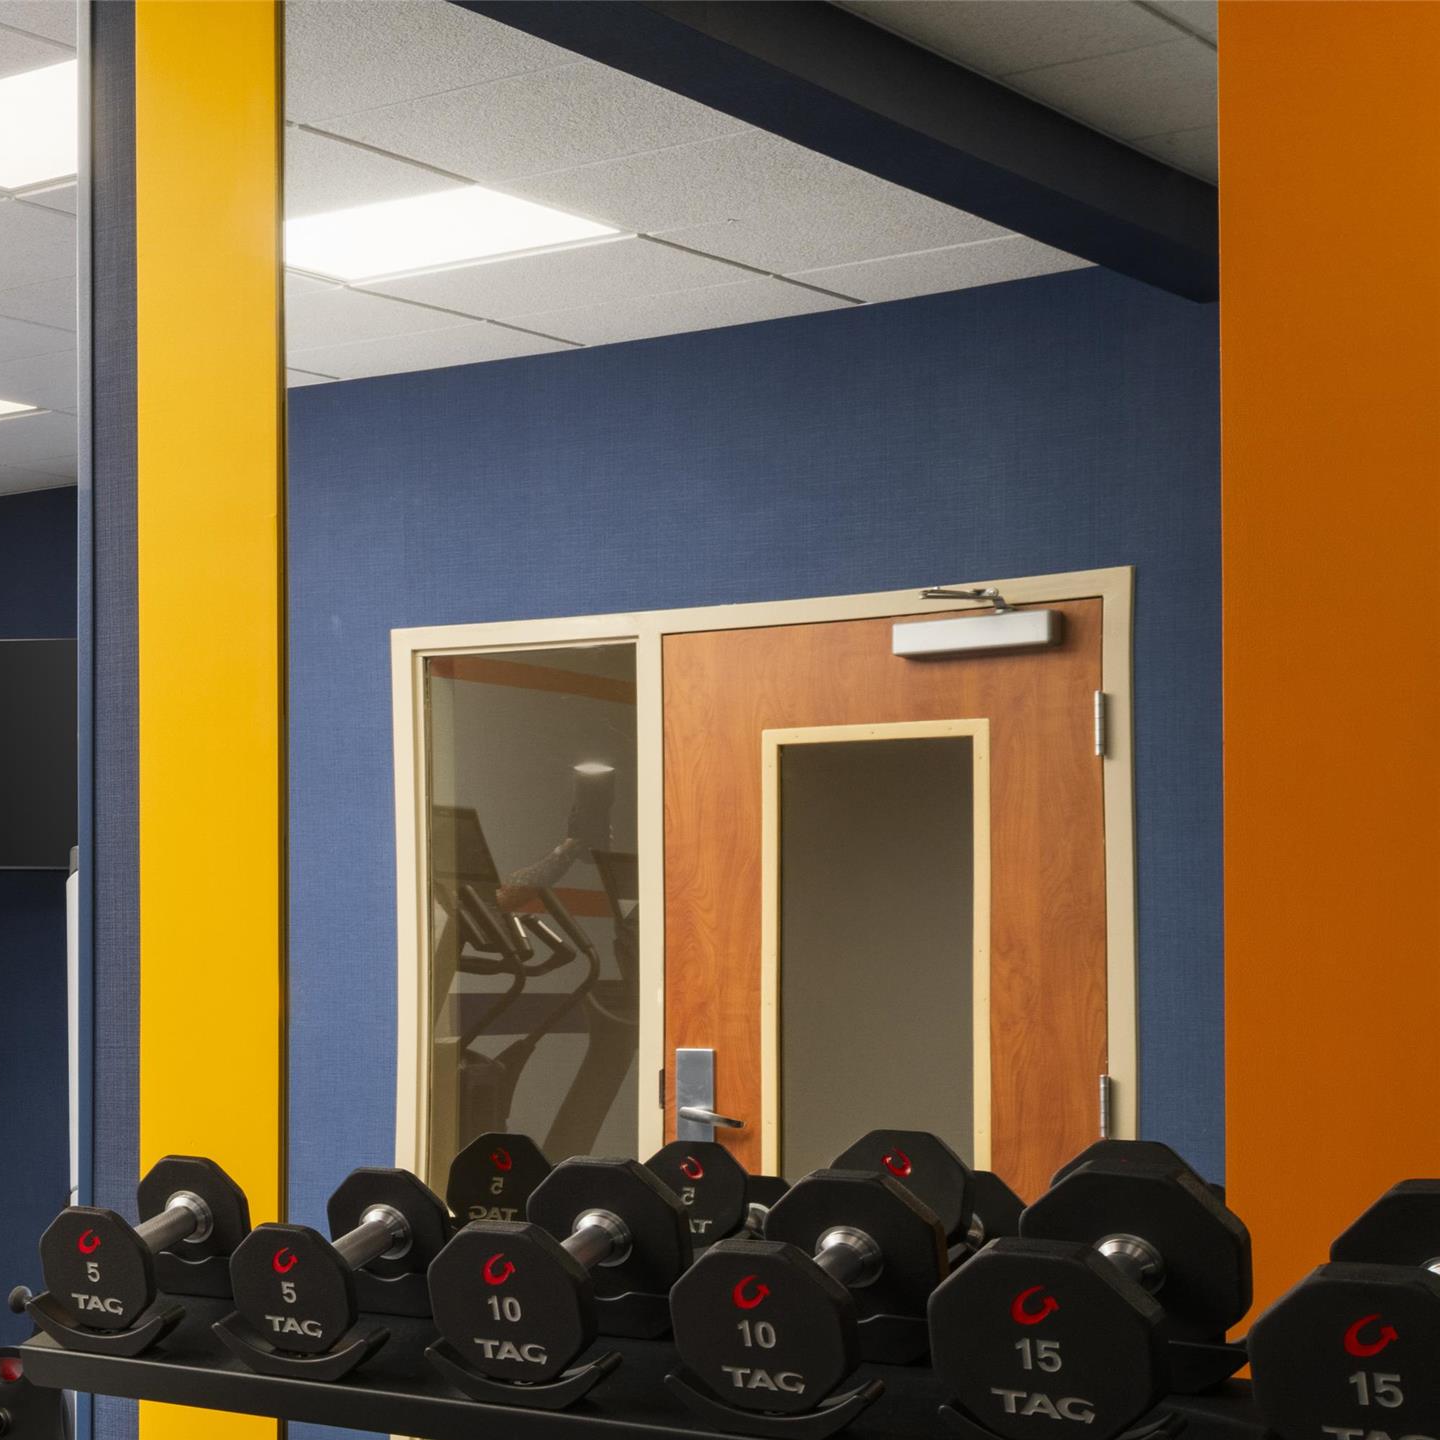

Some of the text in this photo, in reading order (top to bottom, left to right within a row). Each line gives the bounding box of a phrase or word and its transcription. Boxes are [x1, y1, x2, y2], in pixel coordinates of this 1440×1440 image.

[87, 1262, 100, 1282] 5
[72, 1293, 123, 1315] TAG
[282, 1282, 296, 1303] 5
[488, 1296, 521, 1322] 10
[265, 1315, 322, 1338] TAG
[738, 1320, 776, 1348] 10
[474, 1338, 547, 1364] TAG
[1016, 1339, 1062, 1372] 15
[722, 1366, 805, 1394] TAG
[1349, 1372, 1403, 1408] 15
[991, 1388, 1095, 1424] TAG
